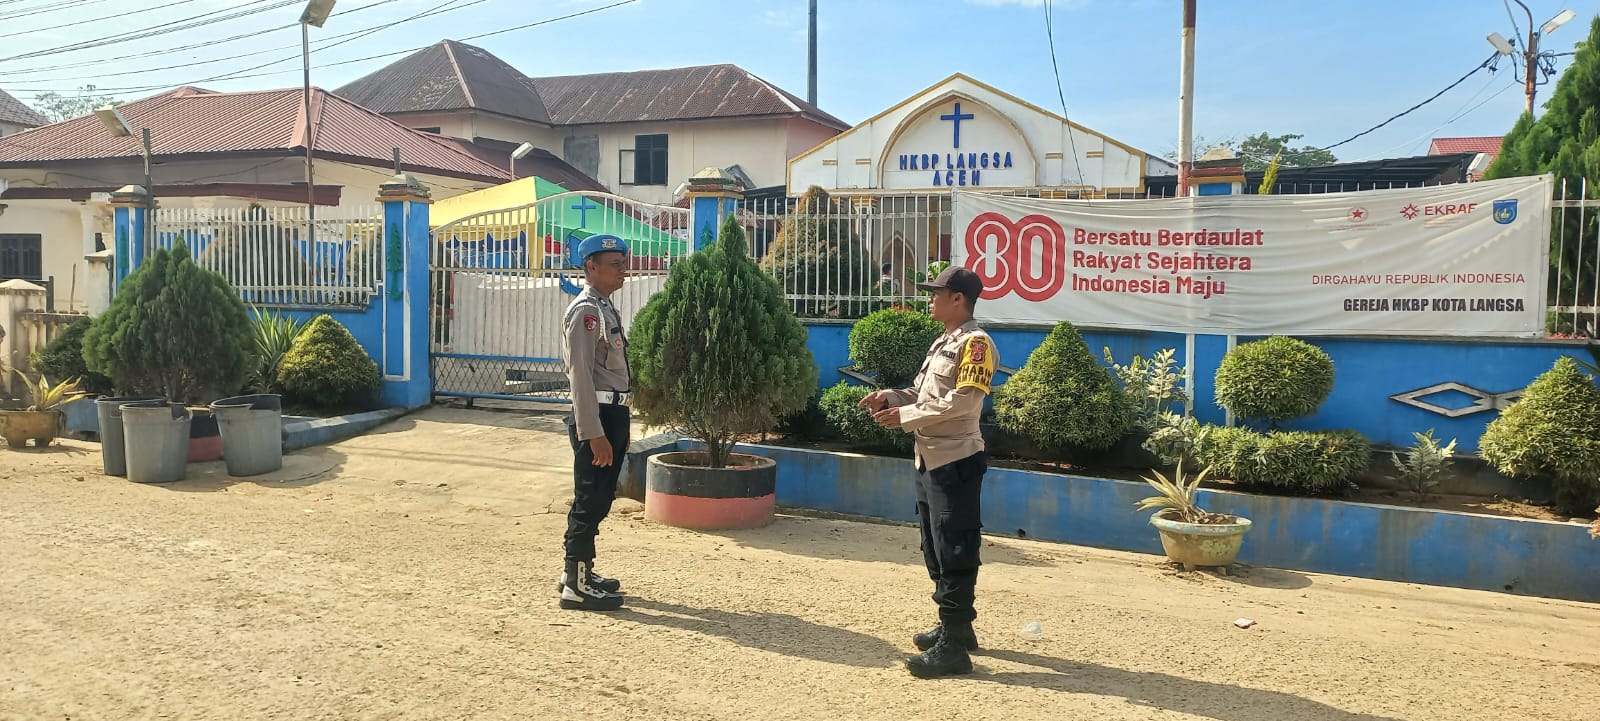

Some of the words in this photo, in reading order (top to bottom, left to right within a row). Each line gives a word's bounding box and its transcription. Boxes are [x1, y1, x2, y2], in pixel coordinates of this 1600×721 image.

[899, 154, 939, 170] HKBP
[946, 151, 1012, 169] LANGSA
[933, 170, 980, 186] ACEH
[1424, 203, 1478, 216] EKRAF
[1074, 228, 1152, 246] Bersatu
[1157, 228, 1264, 247] Berdaulat
[965, 212, 1066, 302] 80
[1073, 250, 1141, 274] Rakyat
[1147, 251, 1252, 275] Sejahtera
[1072, 273, 1170, 295] Indonesia
[1175, 275, 1226, 300] Maju
[1312, 274, 1381, 285] DIRGAHAYU
[1385, 274, 1449, 285] REPUBLIK
[1453, 273, 1525, 284] INDONESIA
[1343, 298, 1390, 312] GEREJA
[1392, 298, 1429, 312] HKBP
[1432, 298, 1467, 312] KOTA
[1469, 298, 1525, 312] LANGSA
